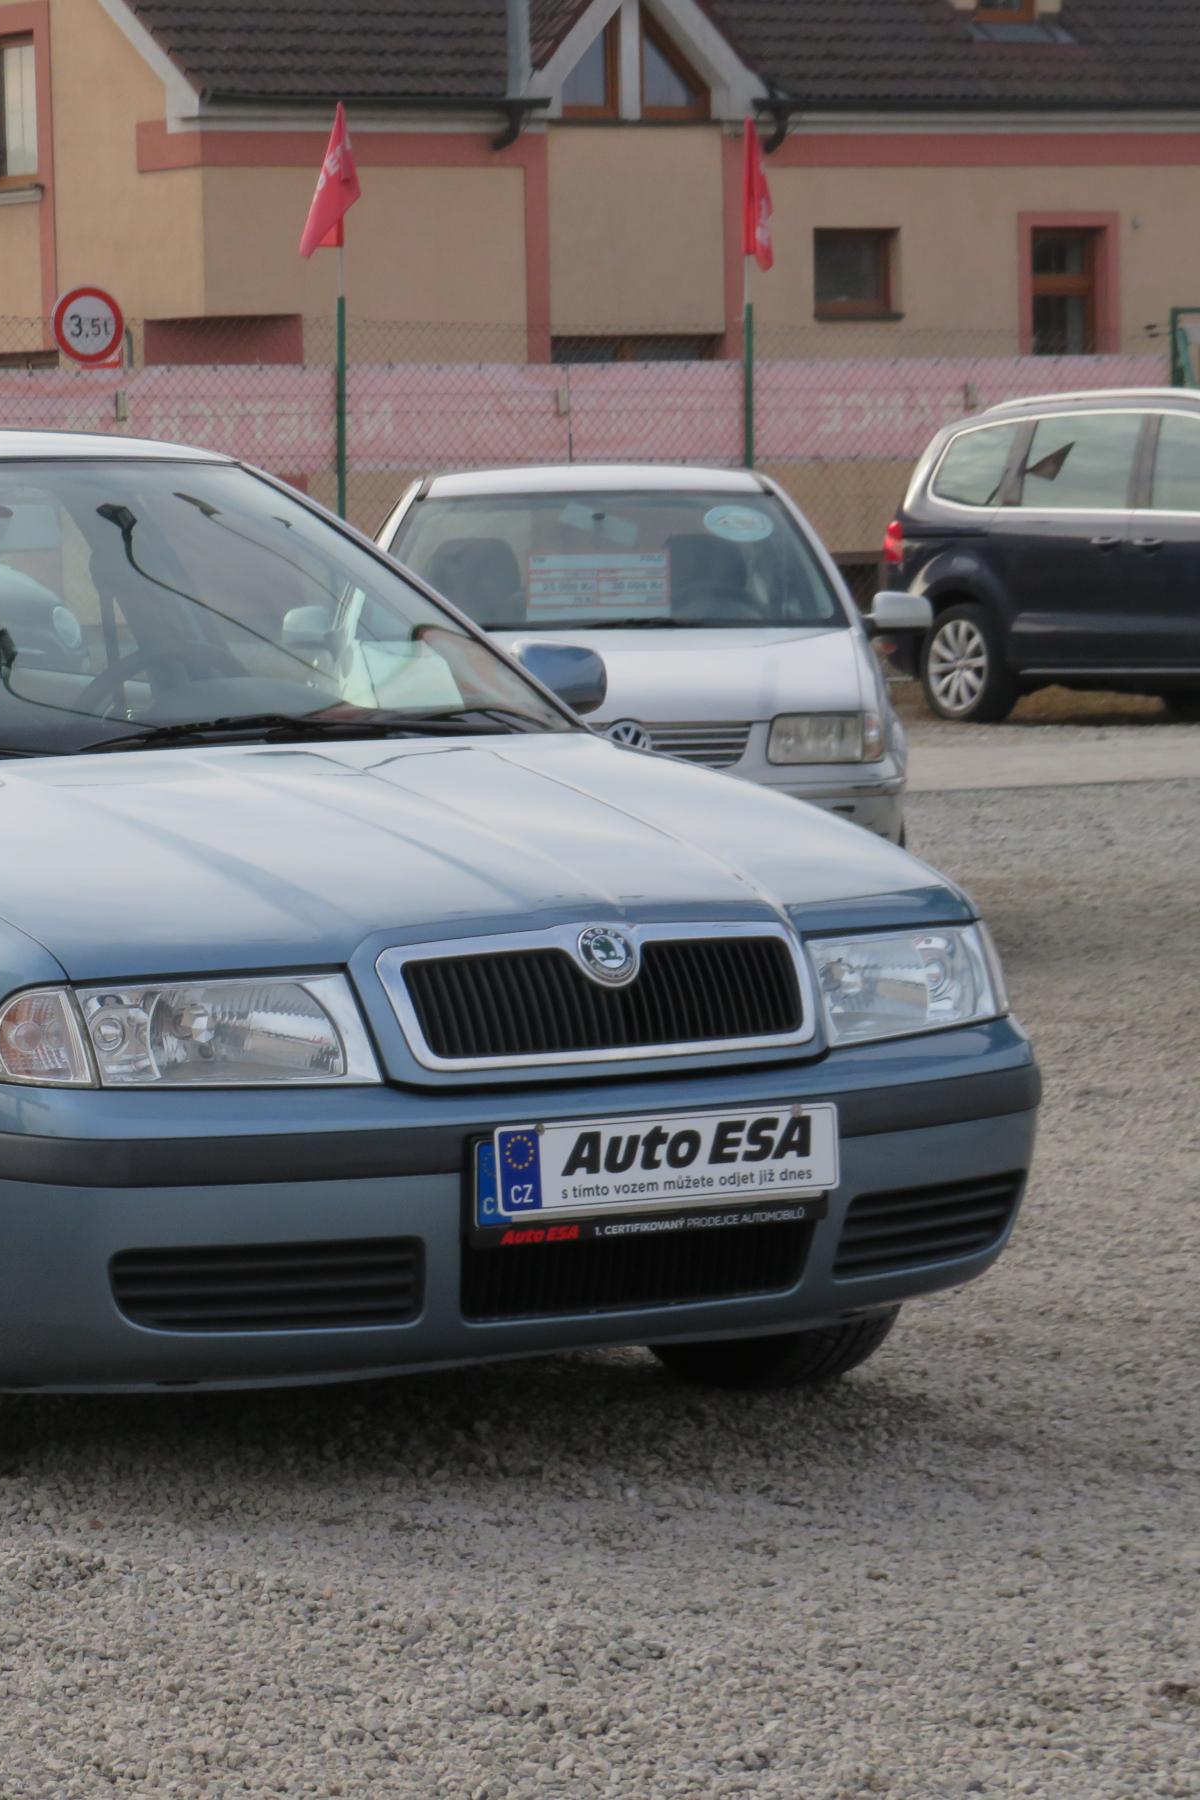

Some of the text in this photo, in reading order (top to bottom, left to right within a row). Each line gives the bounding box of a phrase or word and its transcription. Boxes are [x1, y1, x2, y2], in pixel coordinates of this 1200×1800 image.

[561, 1115, 811, 1176] Auto ESA
[510, 1183, 534, 1204] CZ
[561, 1167, 813, 1199] s tímto vozem můžete odjet již dnes
[482, 1197, 500, 1215] C
[500, 1227, 544, 1246] Auto
[546, 1224, 580, 1241] ESA
[604, 1217, 686, 1236] CERTIFIKOVANÝ
[687, 1214, 739, 1229] PRODEJCE
